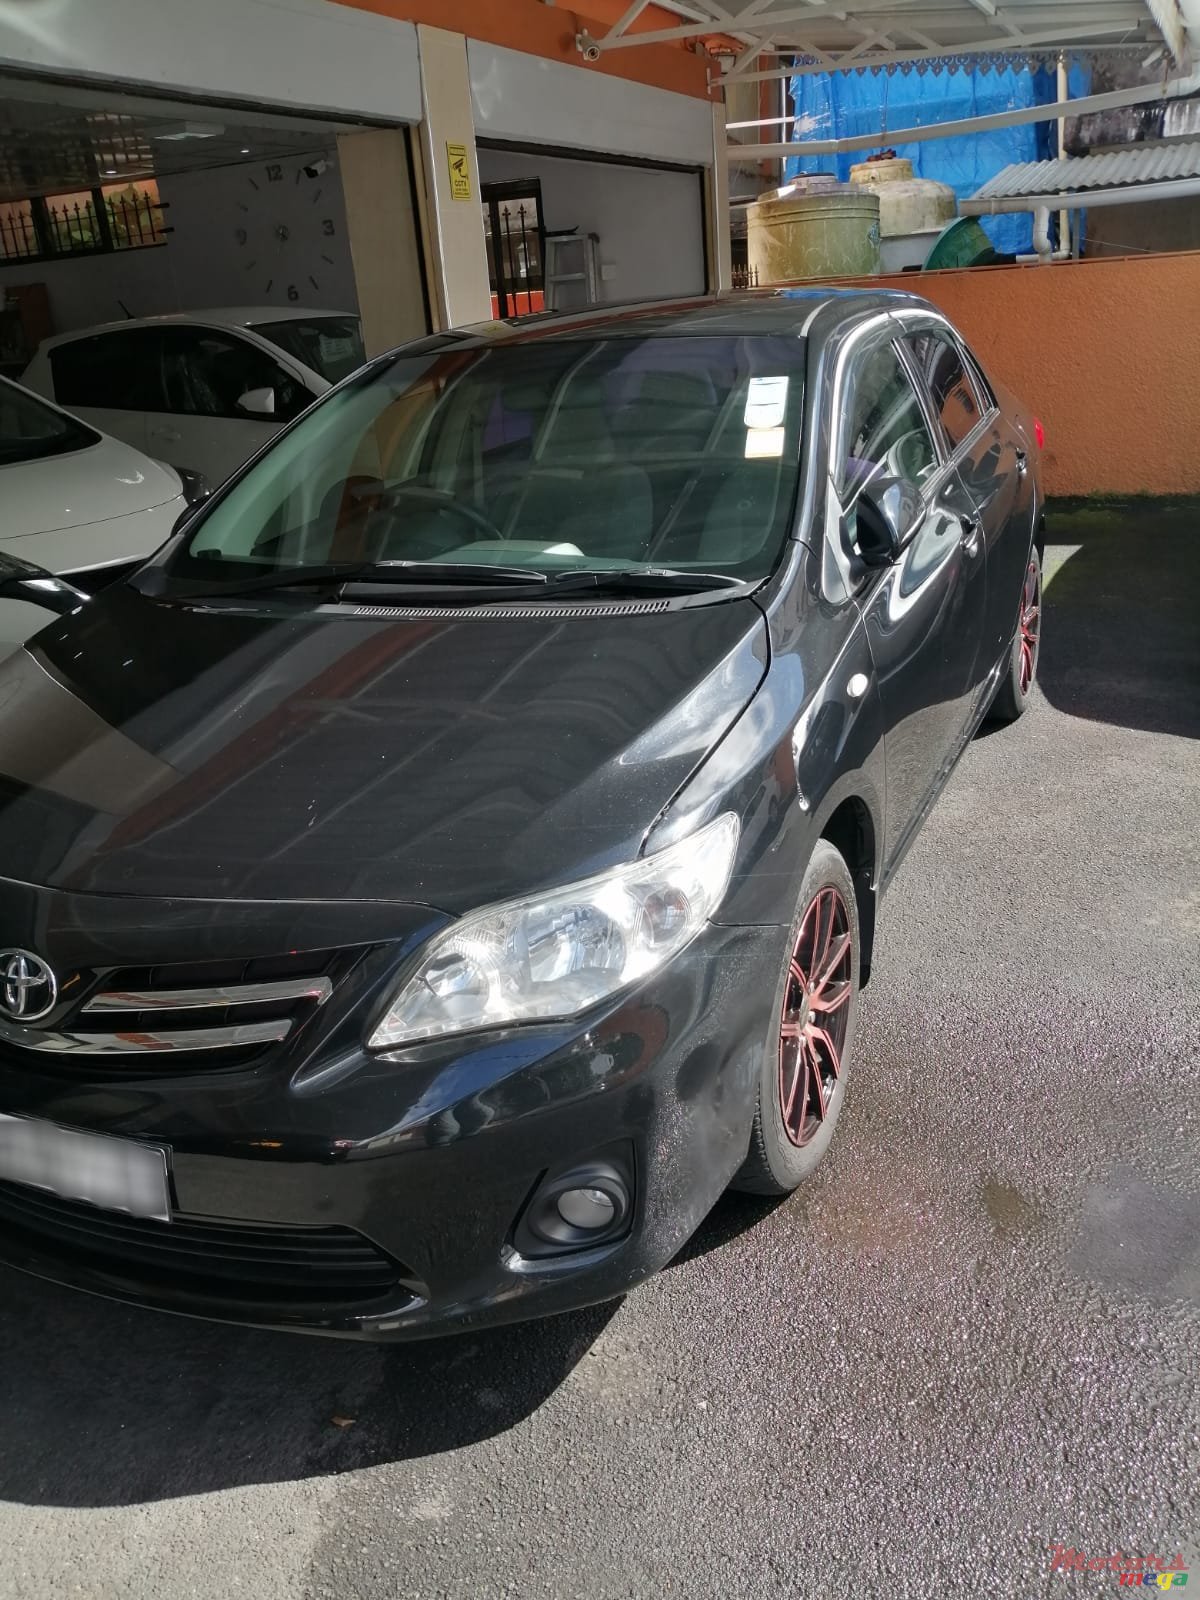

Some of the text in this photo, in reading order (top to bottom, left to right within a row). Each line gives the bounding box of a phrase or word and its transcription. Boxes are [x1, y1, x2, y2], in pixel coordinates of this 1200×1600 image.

[265, 165, 283, 182] 12
[322, 219, 335, 236] 3
[287, 285, 299, 301] 6
